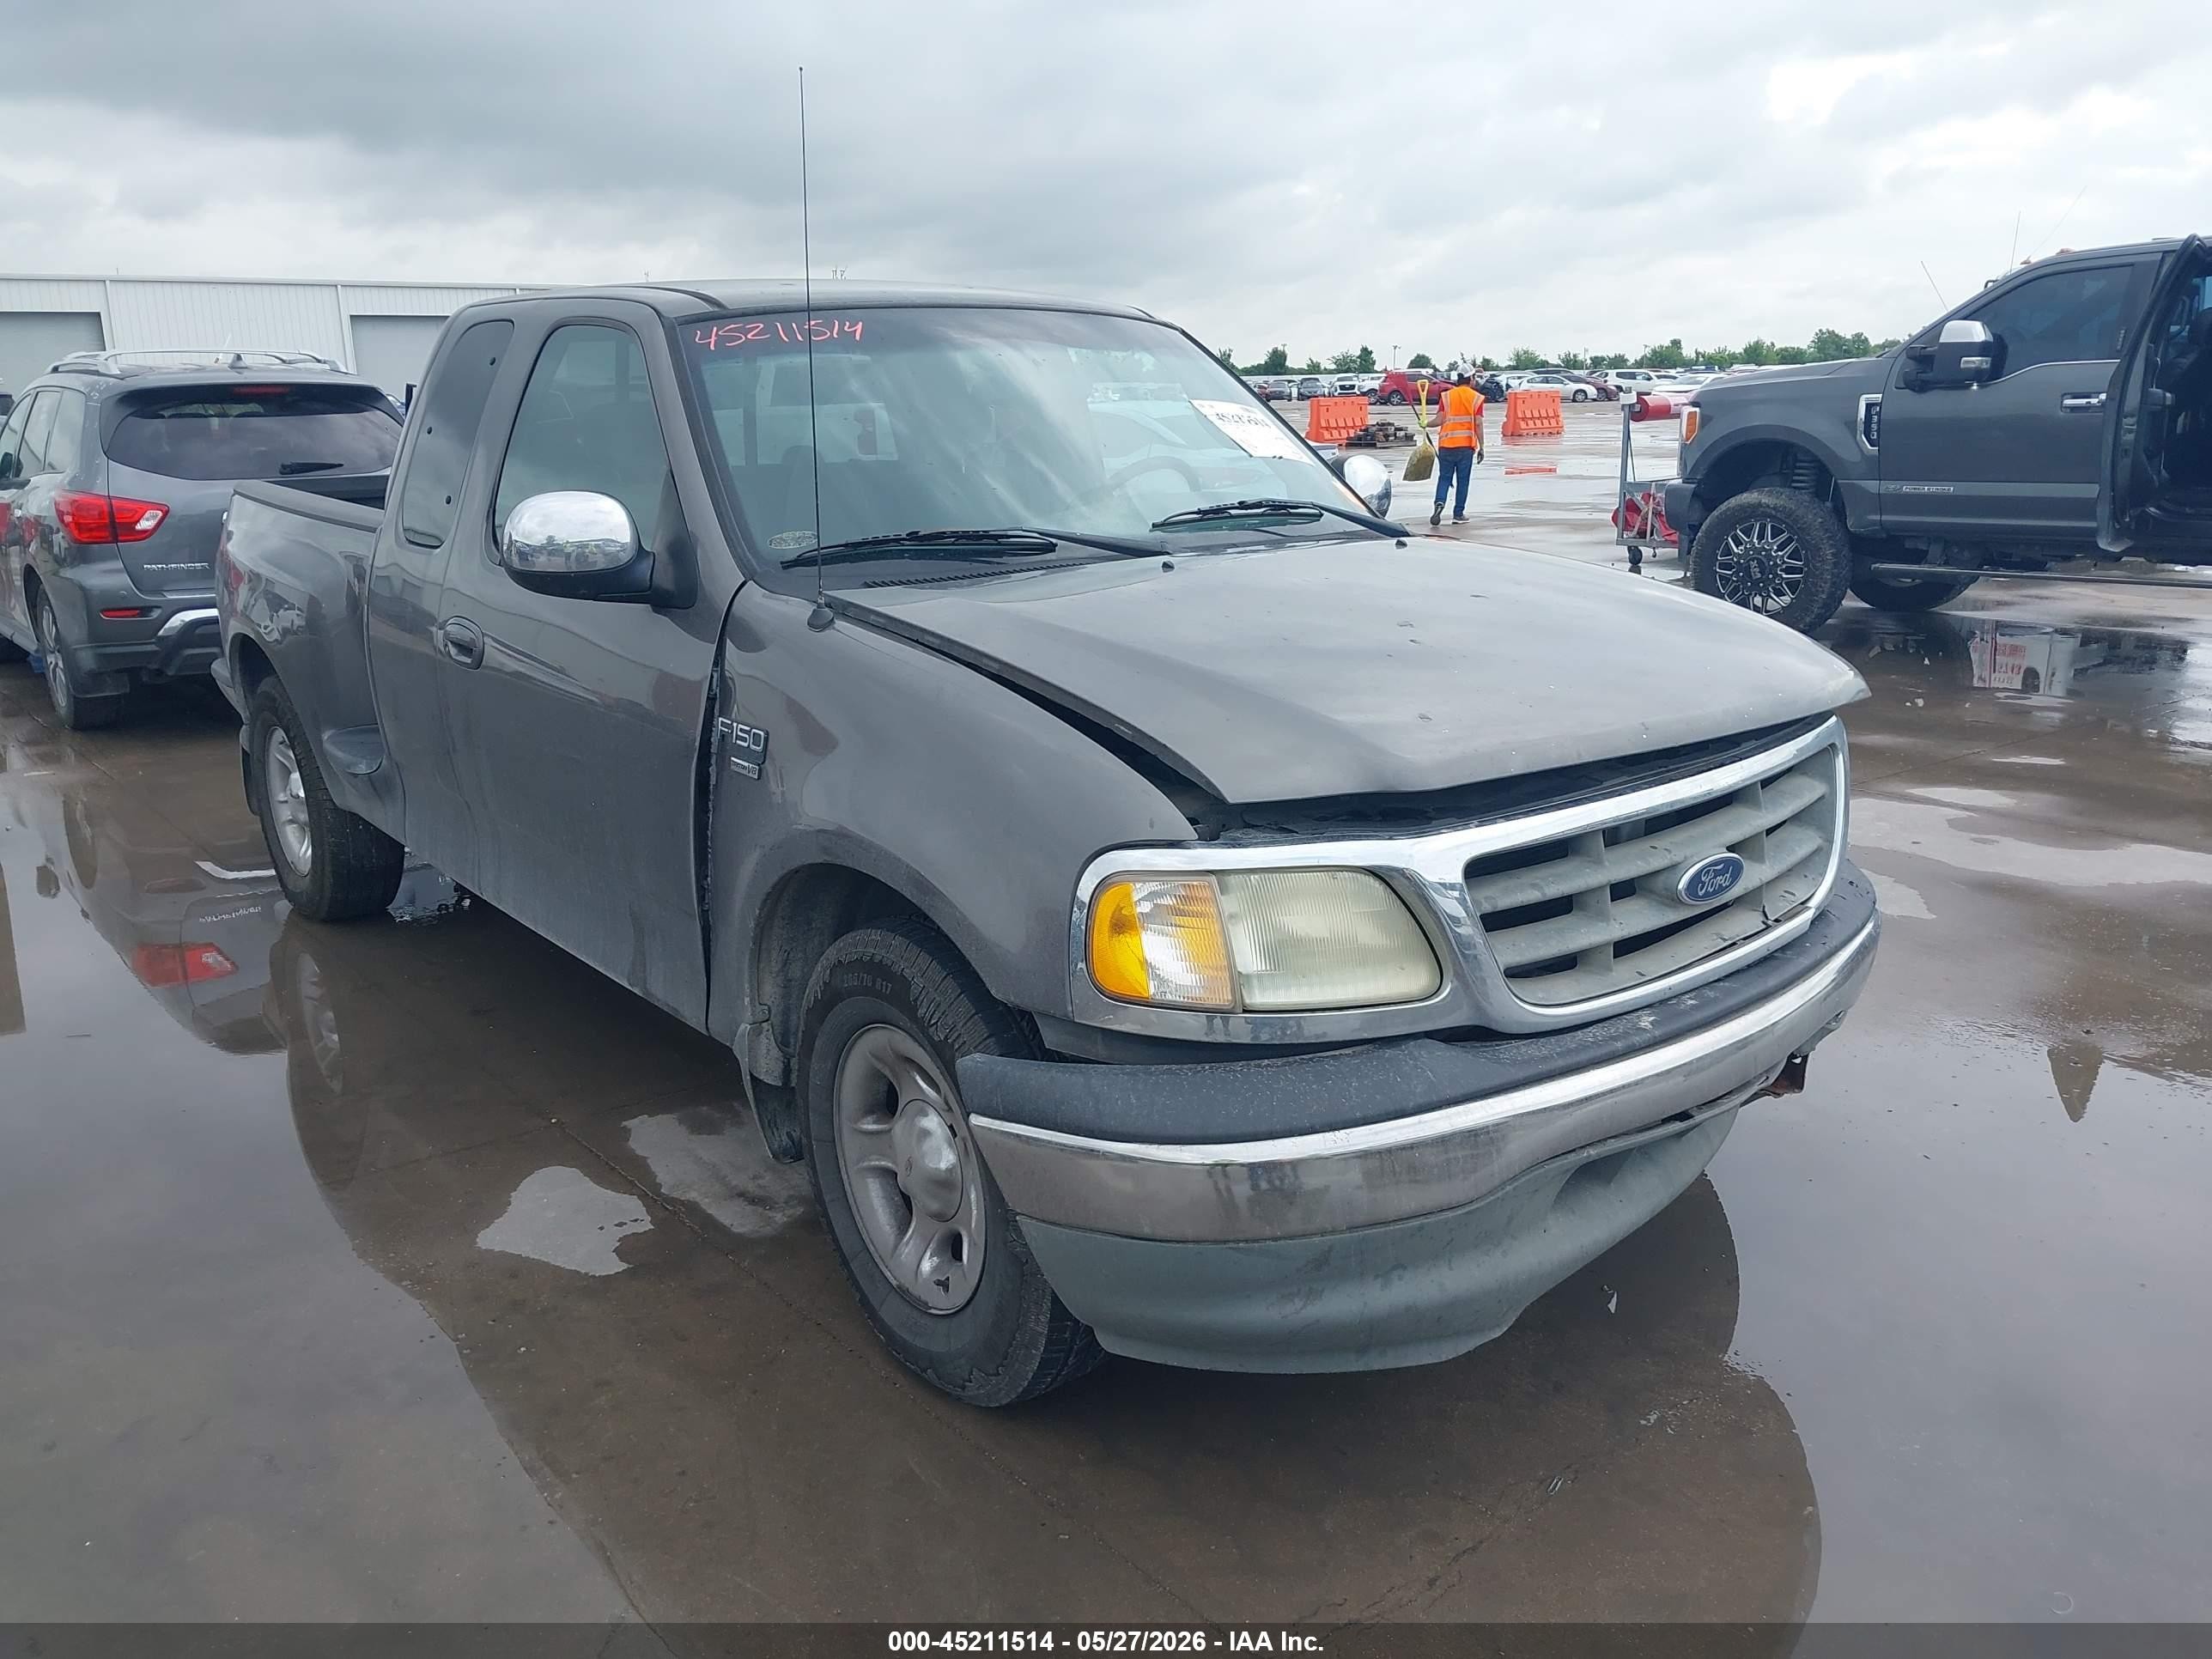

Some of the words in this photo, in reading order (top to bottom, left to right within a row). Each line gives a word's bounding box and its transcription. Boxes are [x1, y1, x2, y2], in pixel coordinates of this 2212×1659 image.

[694, 319, 863, 350] 45211514
[143, 562, 211, 571] PATHFINDER
[1698, 863, 1733, 896] Ford
